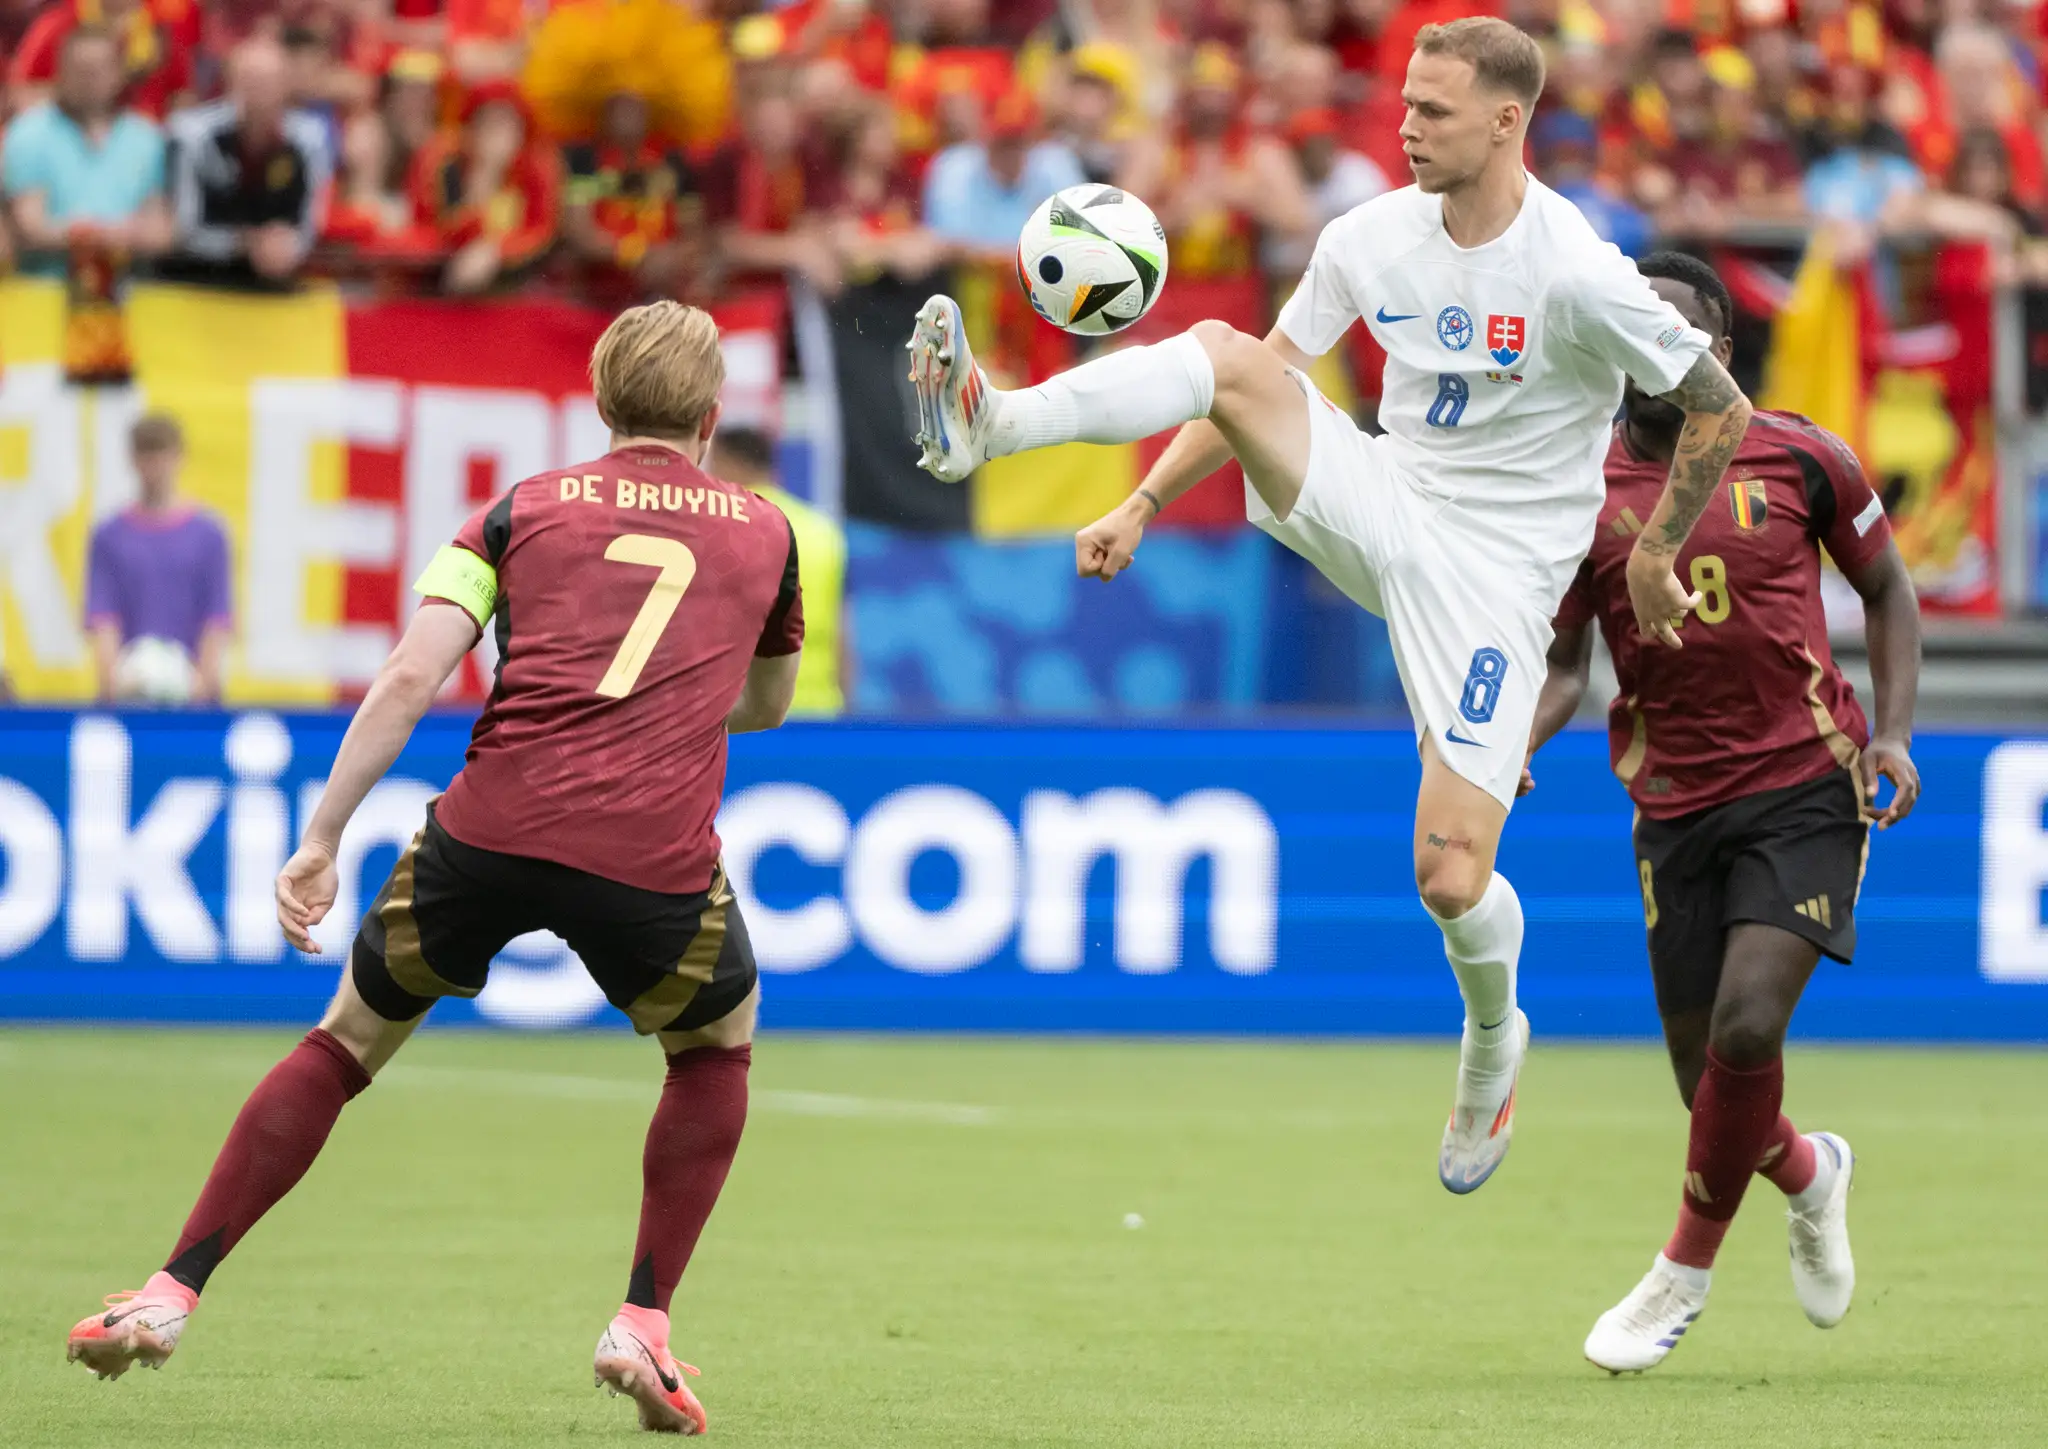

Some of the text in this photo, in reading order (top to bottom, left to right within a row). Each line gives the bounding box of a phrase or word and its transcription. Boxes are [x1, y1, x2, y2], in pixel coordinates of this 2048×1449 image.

[1425, 373, 1469, 427] 8
[560, 475, 750, 523] DE BRUYNE
[595, 534, 697, 699] 7
[1458, 647, 1508, 724] 8
